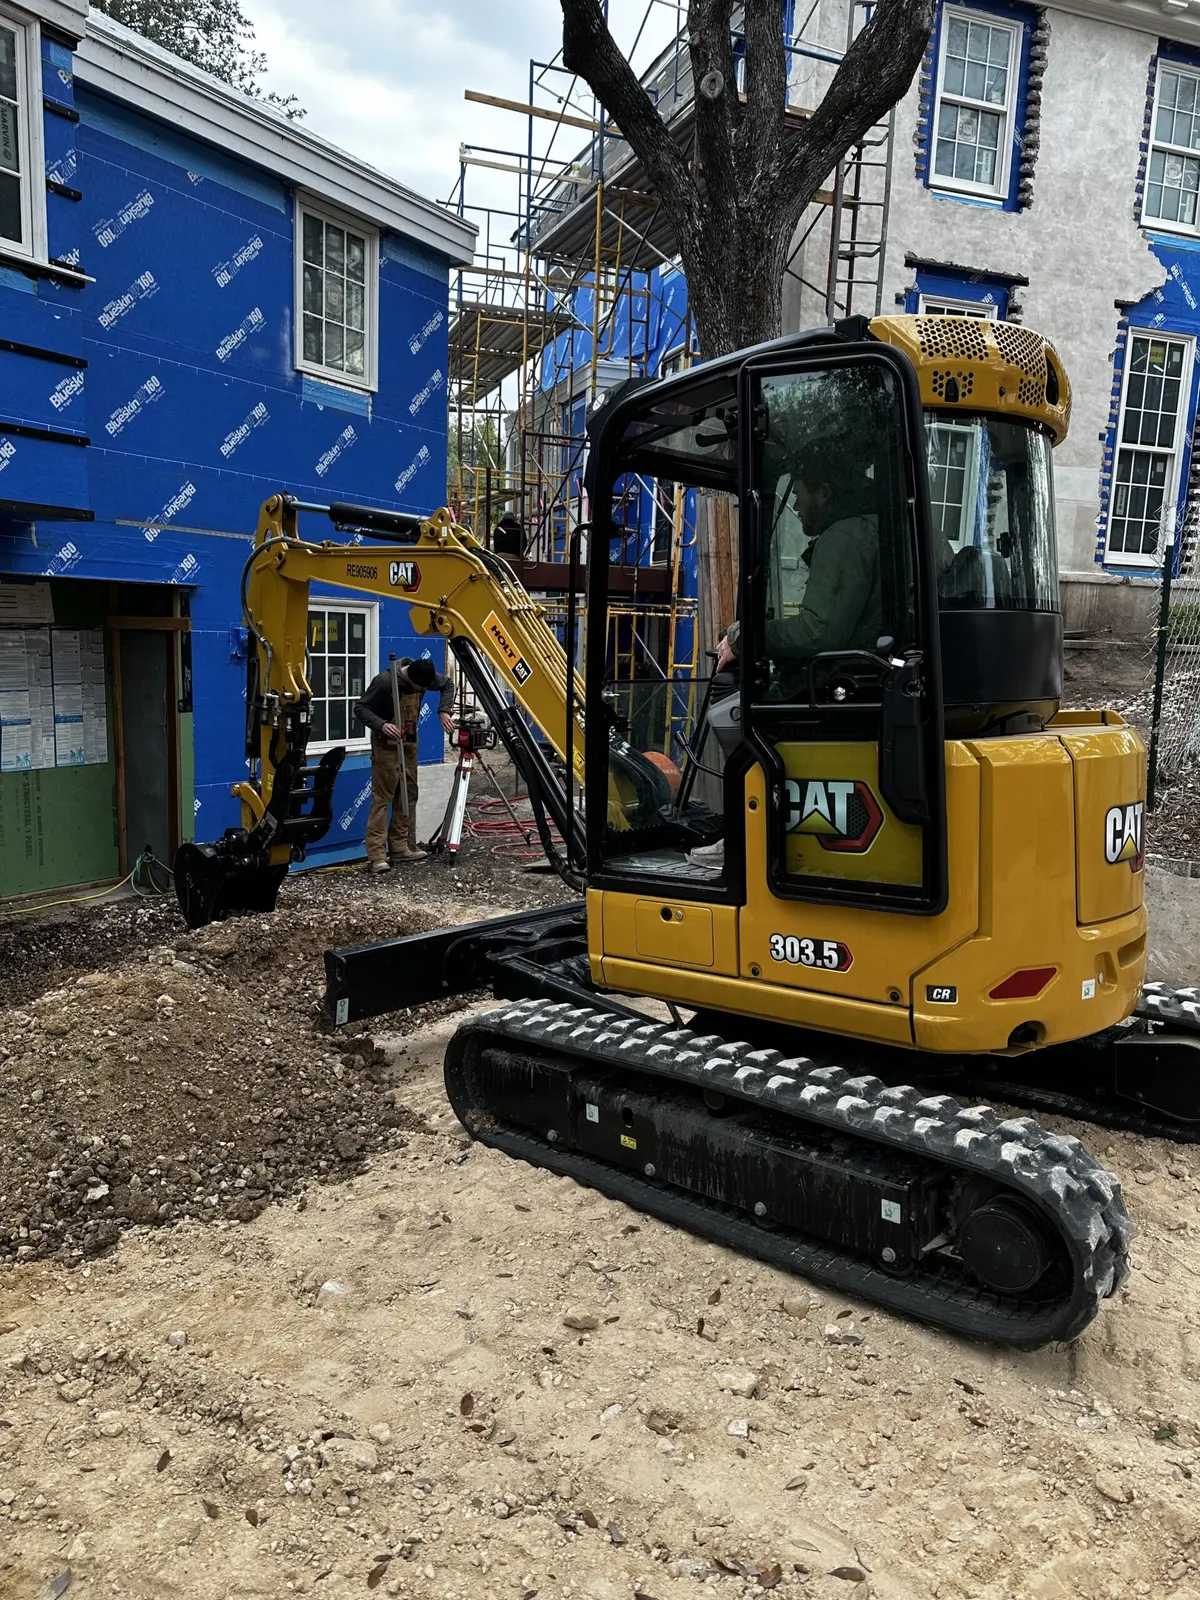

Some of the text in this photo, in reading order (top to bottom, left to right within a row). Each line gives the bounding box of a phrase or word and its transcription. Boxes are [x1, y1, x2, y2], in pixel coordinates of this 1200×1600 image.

[1, 107, 10, 148] MARVIN
[346, 564, 378, 579] RE905906
[390, 562, 414, 585] CAT
[490, 624, 516, 659] HOLT
[514, 662, 528, 680] CAT
[786, 780, 855, 836] CAT
[1106, 803, 1143, 864] CAT
[770, 934, 838, 969] 303.5
[932, 988, 950, 1000] CR
